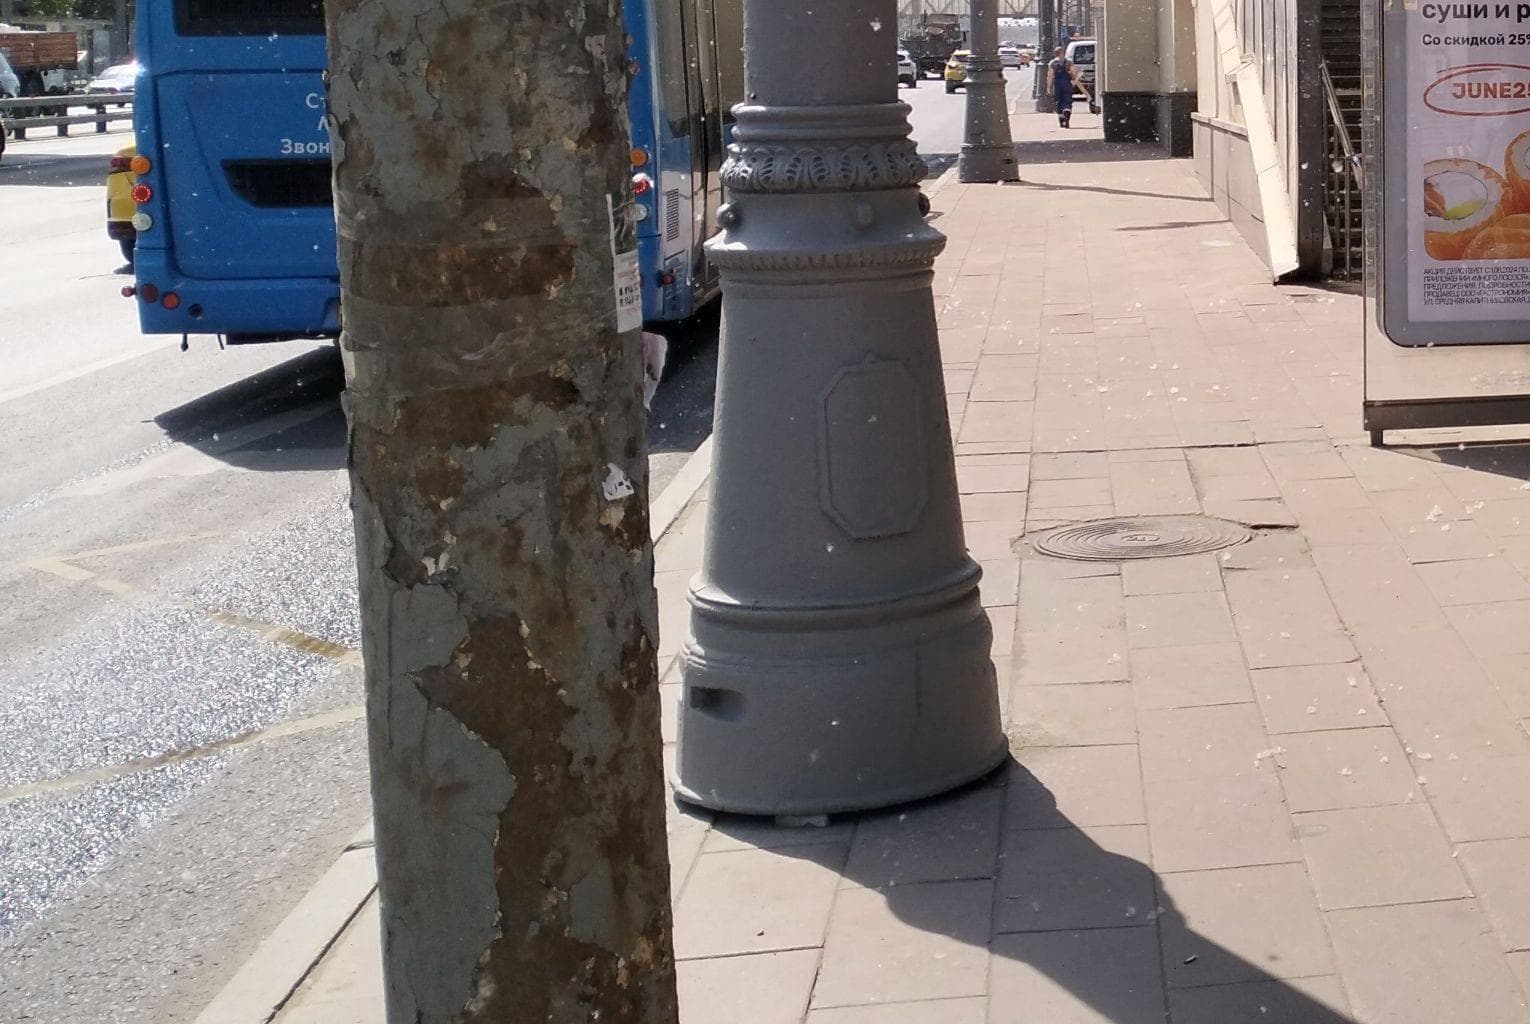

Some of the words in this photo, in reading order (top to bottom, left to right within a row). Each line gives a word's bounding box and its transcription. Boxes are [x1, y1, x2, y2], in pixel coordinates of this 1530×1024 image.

[1422, 3, 1488, 23] суши
[1495, 3, 1510, 19] и
[1422, 34, 1441, 46] Со
[1444, 34, 1505, 47] скидкой
